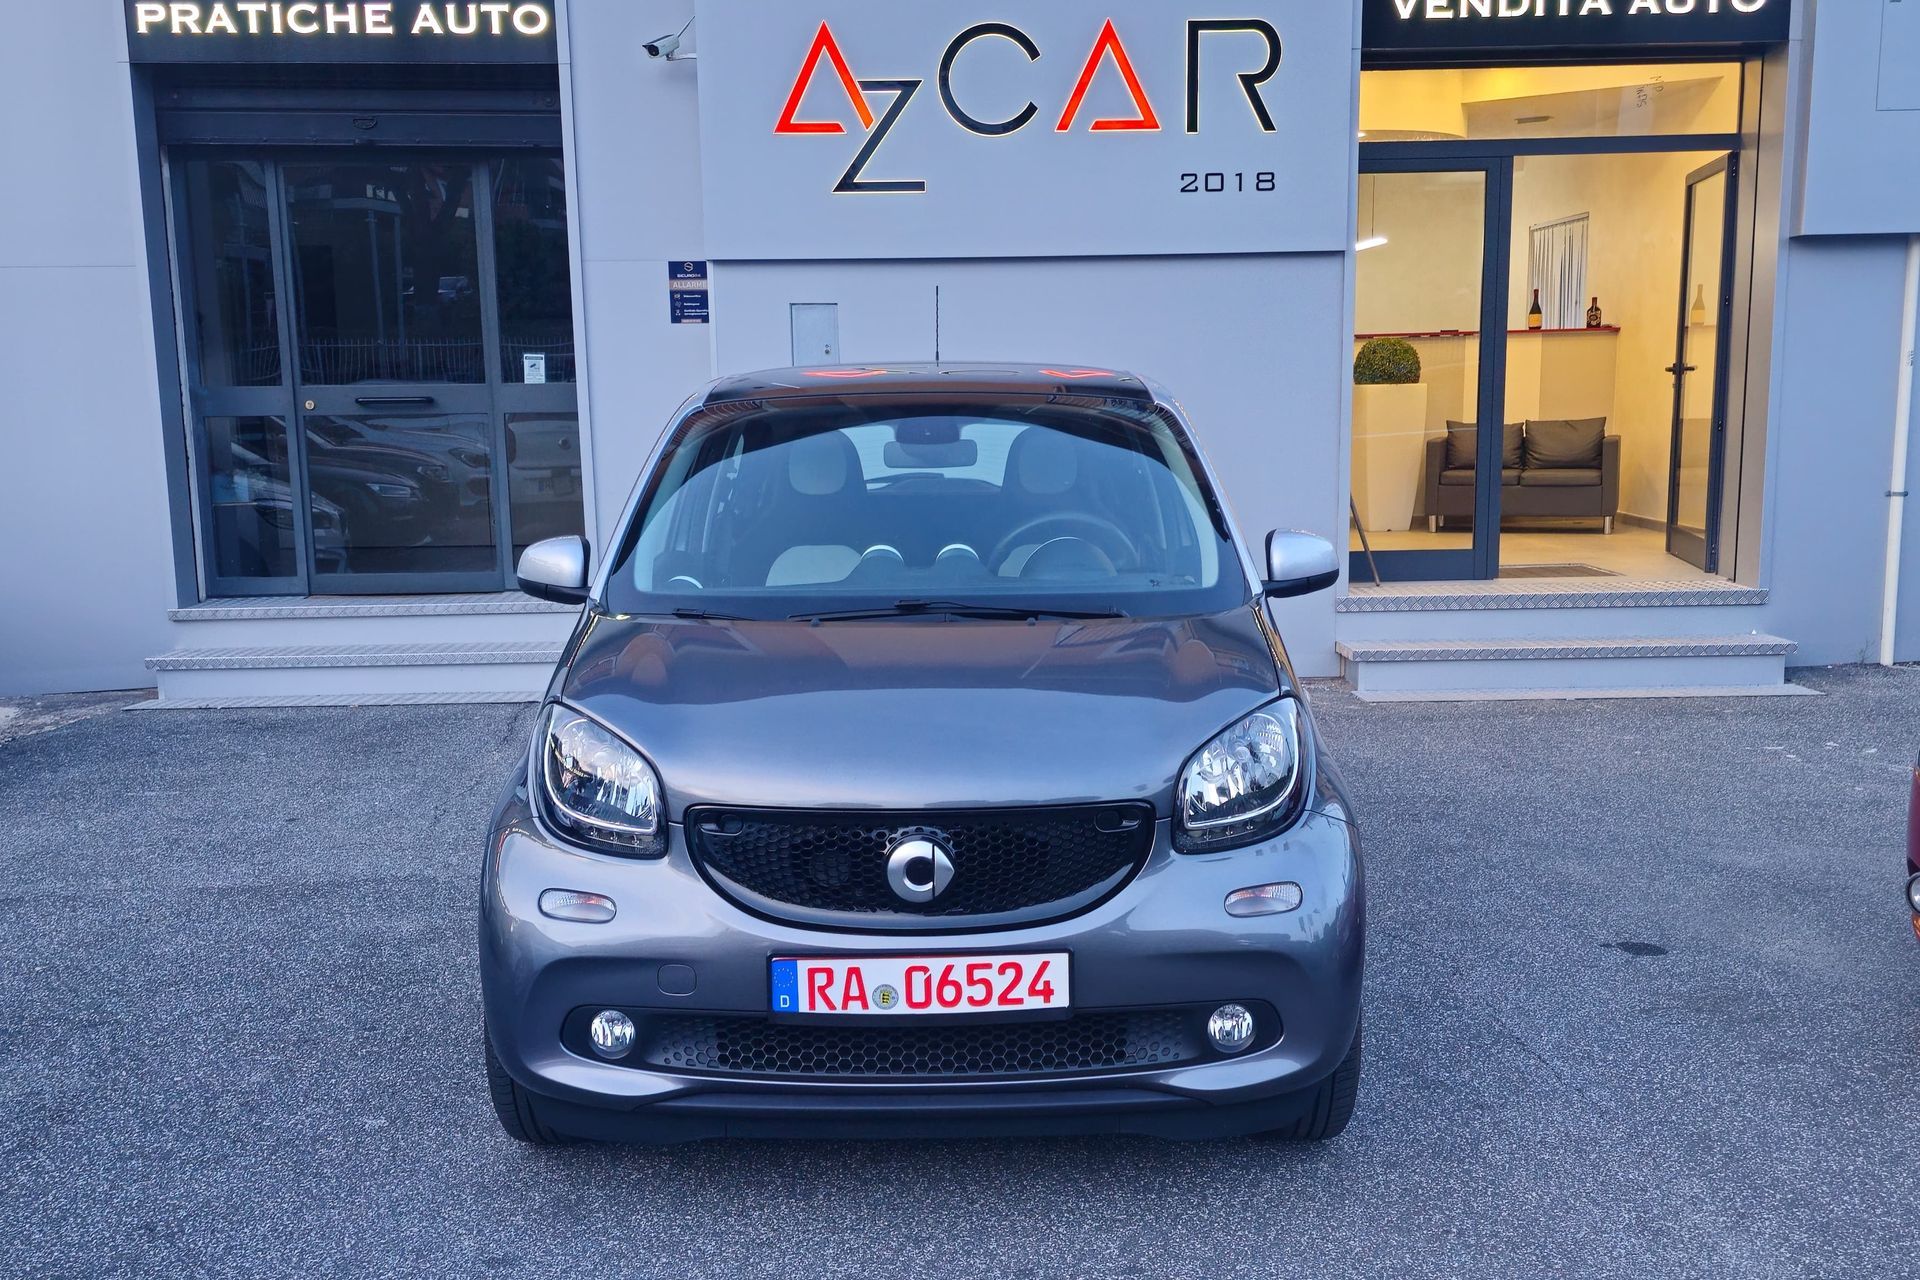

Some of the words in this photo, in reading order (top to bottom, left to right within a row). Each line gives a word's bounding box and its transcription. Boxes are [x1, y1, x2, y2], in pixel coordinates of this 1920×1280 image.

[135, 3, 394, 35] PRATICHE
[410, 3, 549, 35] AUTO
[1180, 171, 1276, 193] 2018
[806, 966, 870, 1012] RA
[904, 960, 1055, 1010] 06524
[779, 994, 790, 1009] D
